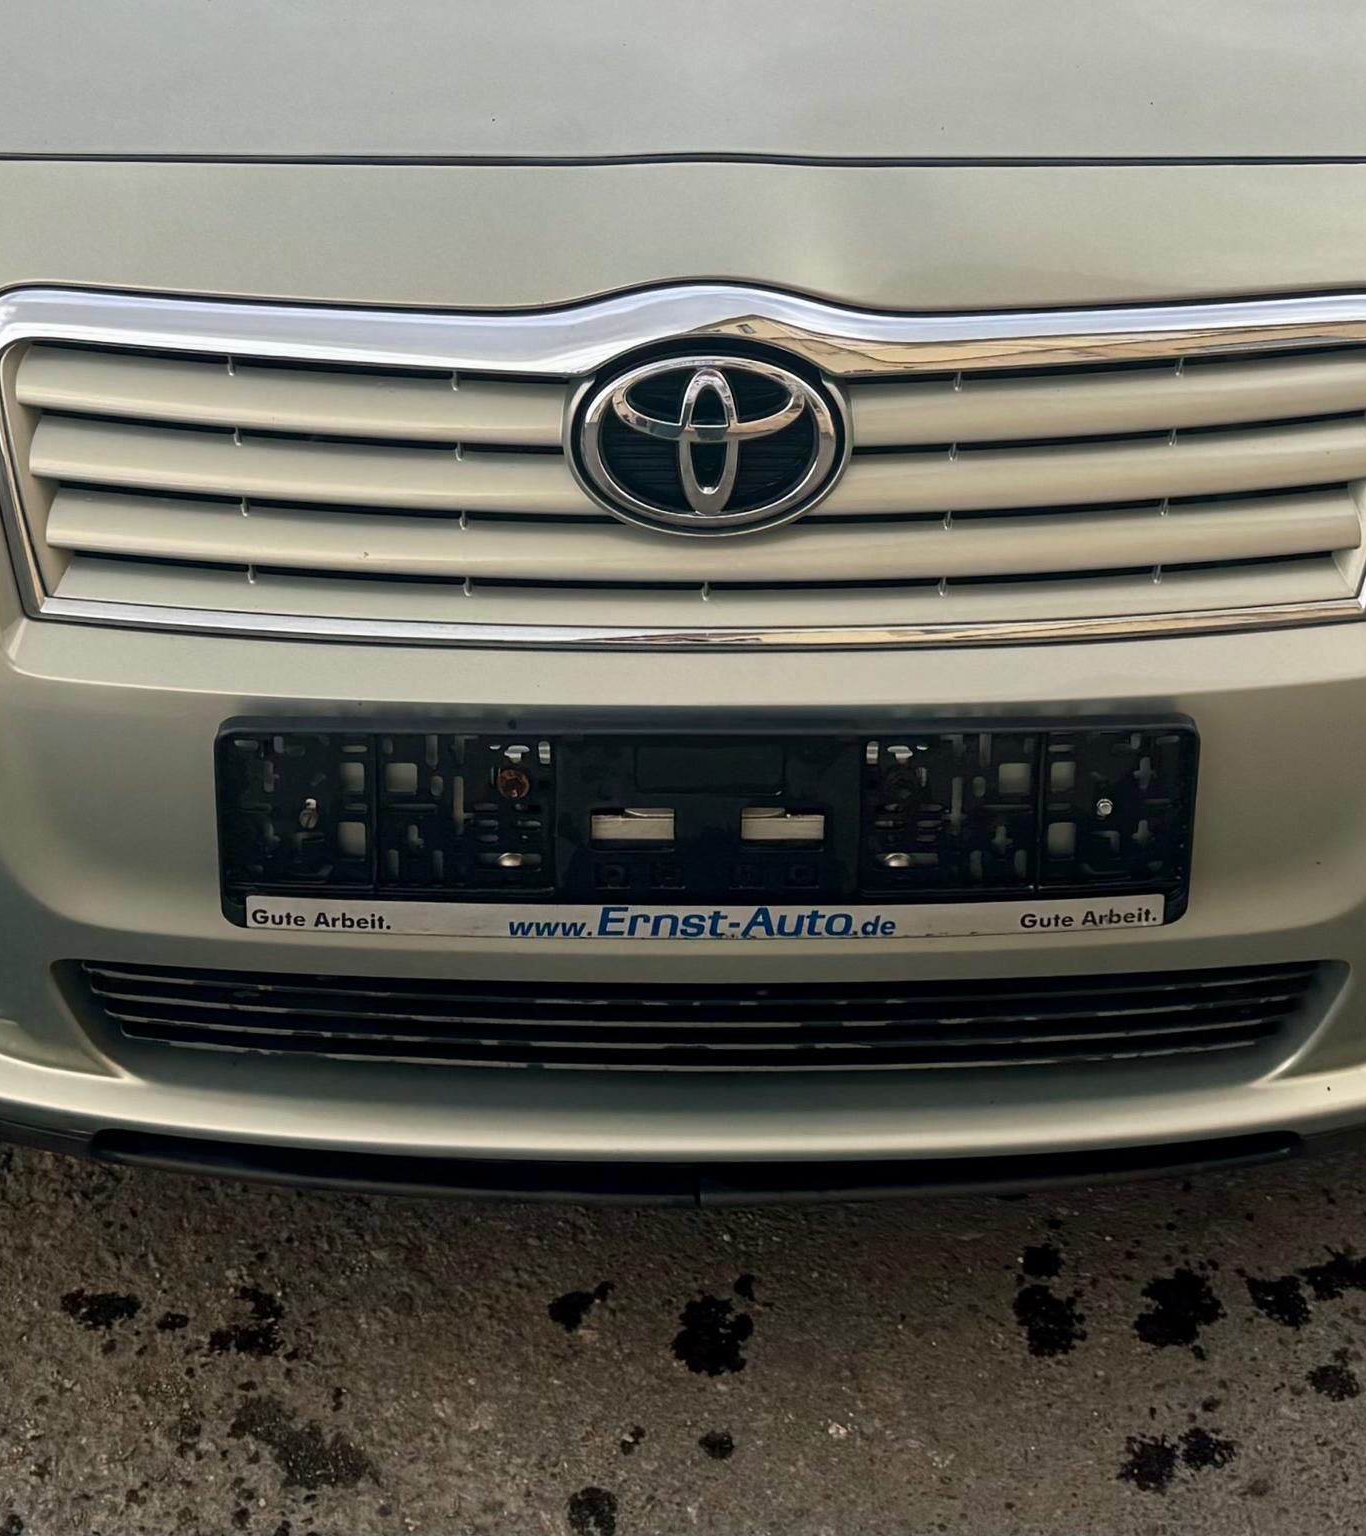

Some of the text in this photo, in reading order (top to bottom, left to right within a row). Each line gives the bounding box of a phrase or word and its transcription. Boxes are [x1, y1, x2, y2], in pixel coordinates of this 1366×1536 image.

[251, 908, 392, 931] Gute Arbeit.
[508, 906, 896, 938] www.Ernst-Auto.de
[1020, 908, 1158, 930] Gute Arbeit.
